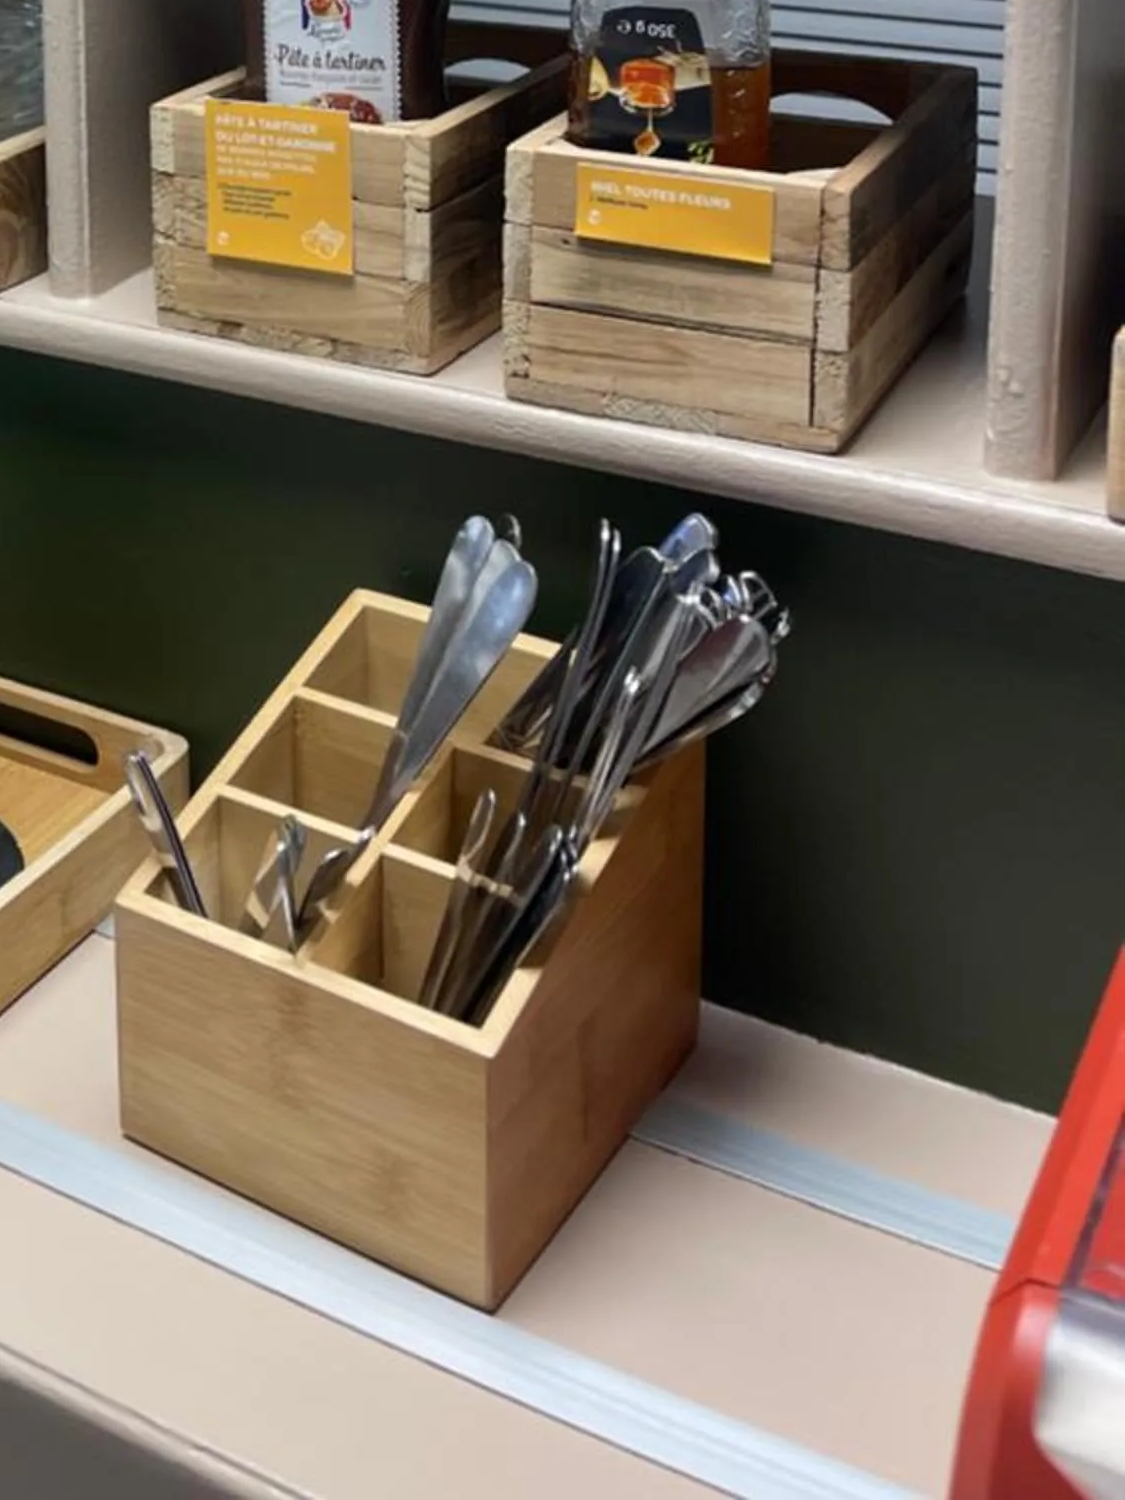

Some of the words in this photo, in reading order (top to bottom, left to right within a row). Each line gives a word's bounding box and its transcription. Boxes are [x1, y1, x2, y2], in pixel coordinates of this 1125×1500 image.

[647, 23, 677, 39] 350
[275, 43, 309, 69] Pâte
[325, 50, 387, 72] tartiner
[259, 118, 318, 134] TARTINER
[625, 184, 675, 204] TOUTES
[679, 191, 732, 210] FLEURS
